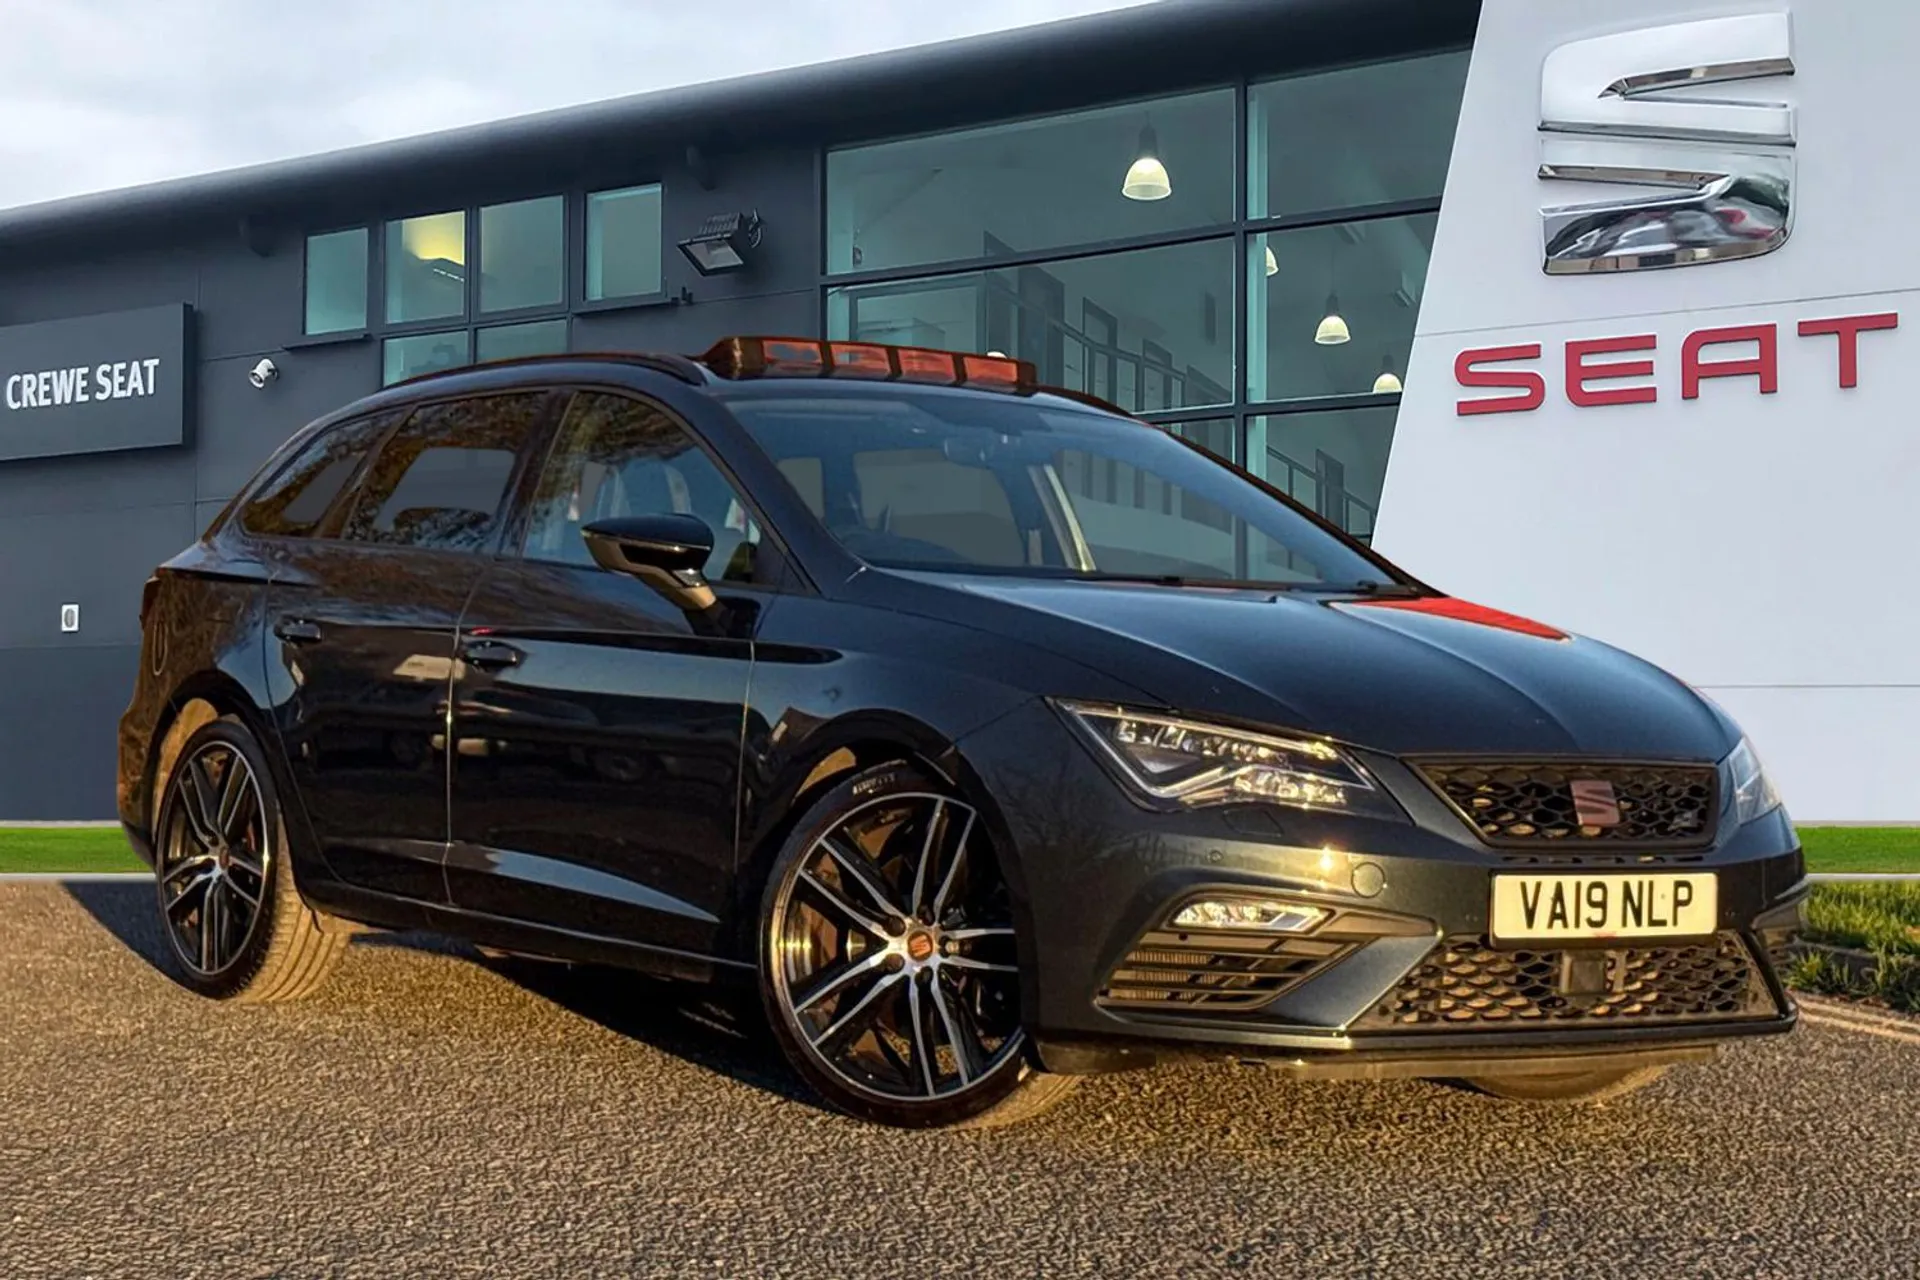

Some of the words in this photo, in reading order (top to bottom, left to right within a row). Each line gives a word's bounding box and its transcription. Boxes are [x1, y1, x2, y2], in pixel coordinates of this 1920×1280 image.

[6, 366, 89, 409] CREWE
[95, 358, 160, 400] SEAT
[1454, 312, 1898, 416] SEAT
[1520, 880, 1608, 929] VA19
[1621, 880, 1693, 928] NLP
